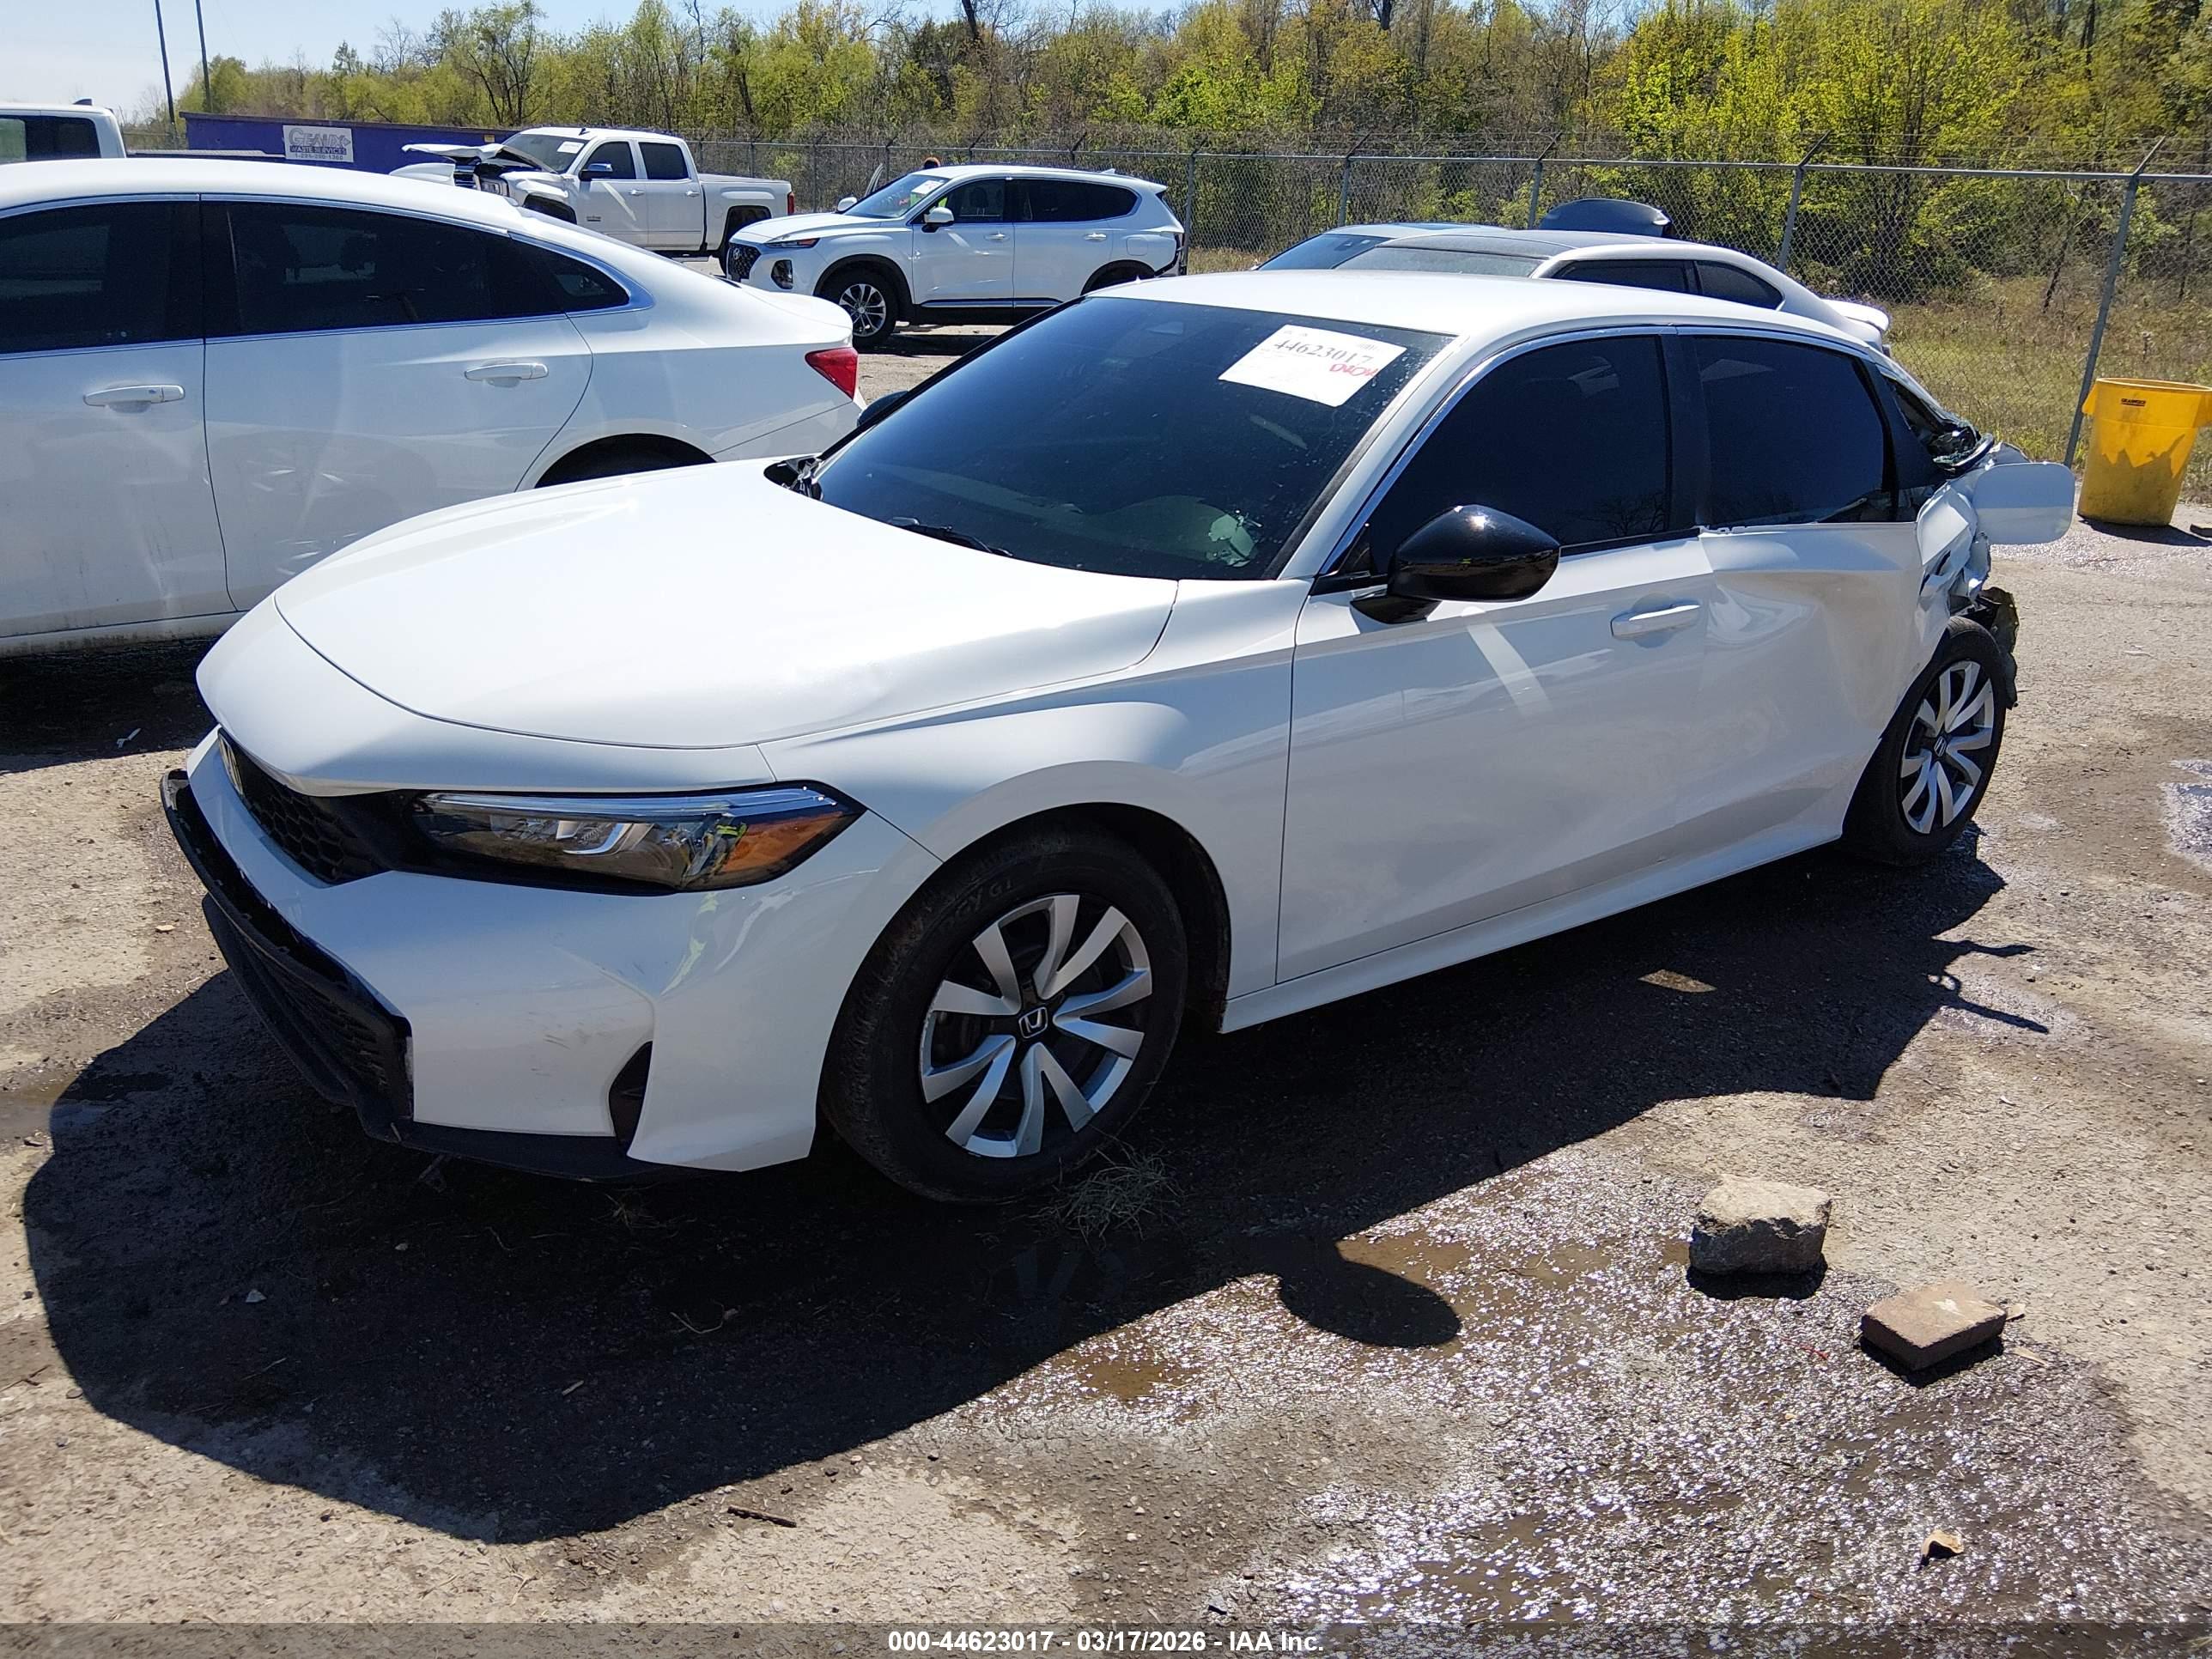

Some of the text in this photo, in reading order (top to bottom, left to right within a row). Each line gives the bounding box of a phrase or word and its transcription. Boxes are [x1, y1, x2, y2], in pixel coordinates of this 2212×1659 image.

[289, 127, 346, 148] GEAUX
[314, 146, 347, 155] SERVICES
[1273, 339, 1374, 363] 44623017
